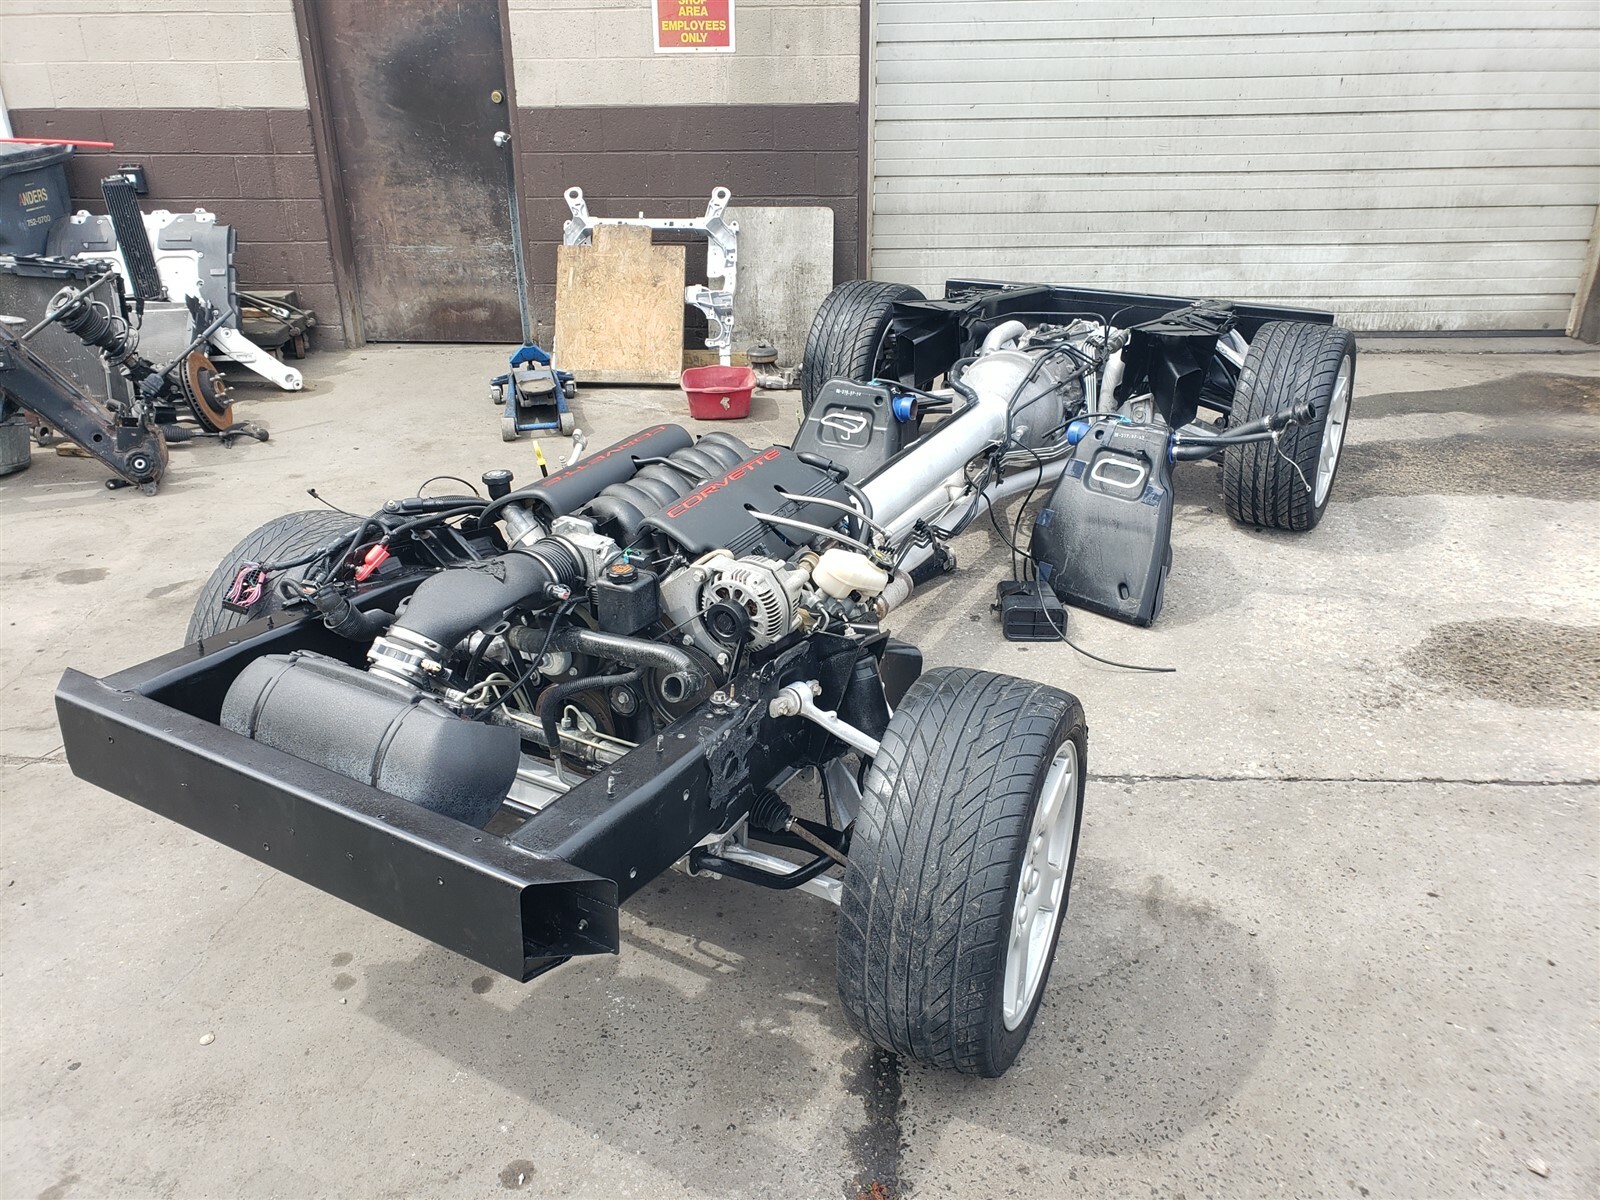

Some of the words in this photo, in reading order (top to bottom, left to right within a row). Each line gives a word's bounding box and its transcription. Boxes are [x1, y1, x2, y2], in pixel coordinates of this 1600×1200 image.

[678, 6, 708, 16] AREA
[661, 20, 726, 31] EMPLOYEES
[680, 32, 708, 43] ONLY
[666, 449, 781, 518] CORVETTE
